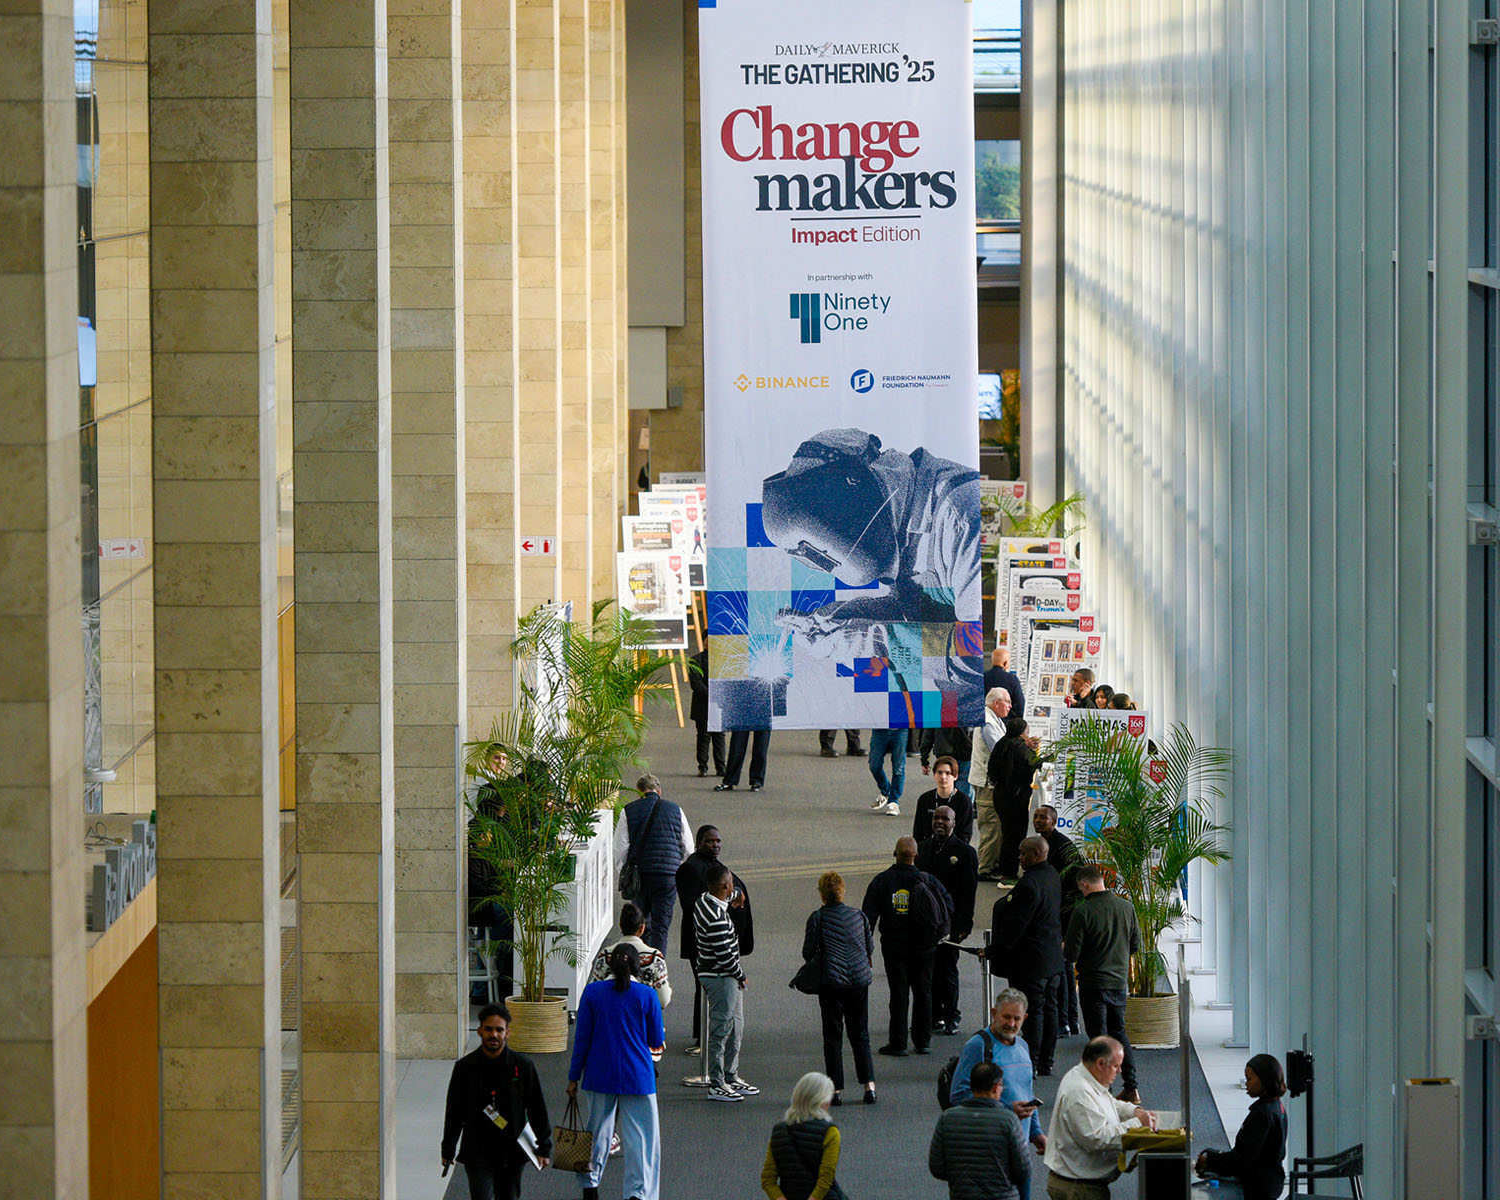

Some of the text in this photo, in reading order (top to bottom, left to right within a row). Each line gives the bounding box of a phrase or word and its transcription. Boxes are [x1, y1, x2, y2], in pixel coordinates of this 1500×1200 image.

[775, 42, 900, 56] DAILY MAVERICK
[740, 54, 935, 85] THE GATHERING '25
[720, 105, 920, 173] Change
[754, 155, 957, 212] makers
[791, 226, 921, 246] Impact Edition
[807, 272, 873, 283] In partnership with
[824, 292, 891, 314] Ninety
[824, 312, 869, 331] One
[756, 376, 830, 389] BINANCE
[1081, 618, 1093, 627] 168
[1019, 615, 1029, 659] MAVERICK
[1088, 639, 1100, 648] 168
[1030, 634, 1042, 679] MAVERICK
[1130, 719, 1144, 728] 168
[1055, 713, 1069, 809] DAILY MARICK
